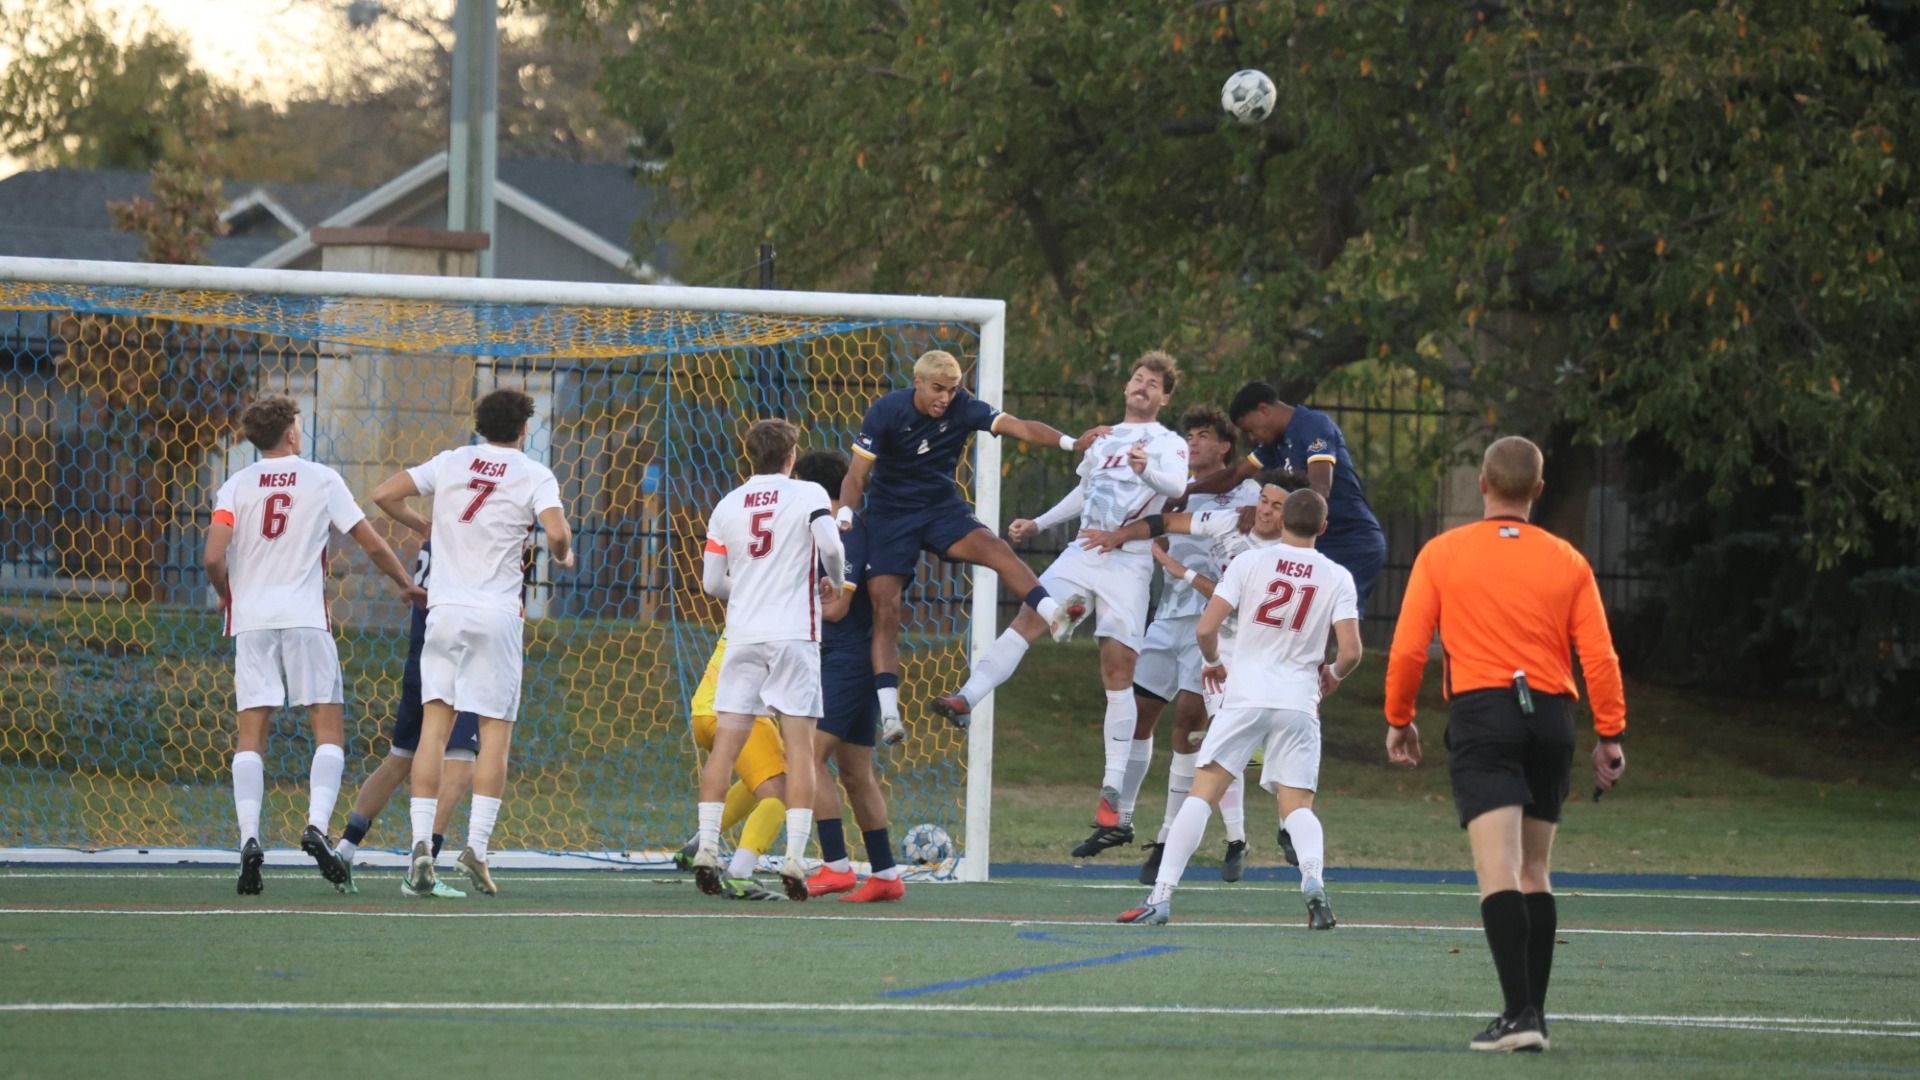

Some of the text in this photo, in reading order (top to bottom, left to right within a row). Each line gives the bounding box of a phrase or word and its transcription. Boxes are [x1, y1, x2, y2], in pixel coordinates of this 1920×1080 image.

[260, 472, 296, 487] MESA
[470, 459, 507, 477] MESA
[459, 477, 498, 523] 7
[744, 490, 779, 508] MESA
[260, 492, 293, 541] 6
[747, 510, 775, 560] 5
[1276, 559, 1313, 578] MESA
[1254, 579, 1318, 632] 21
